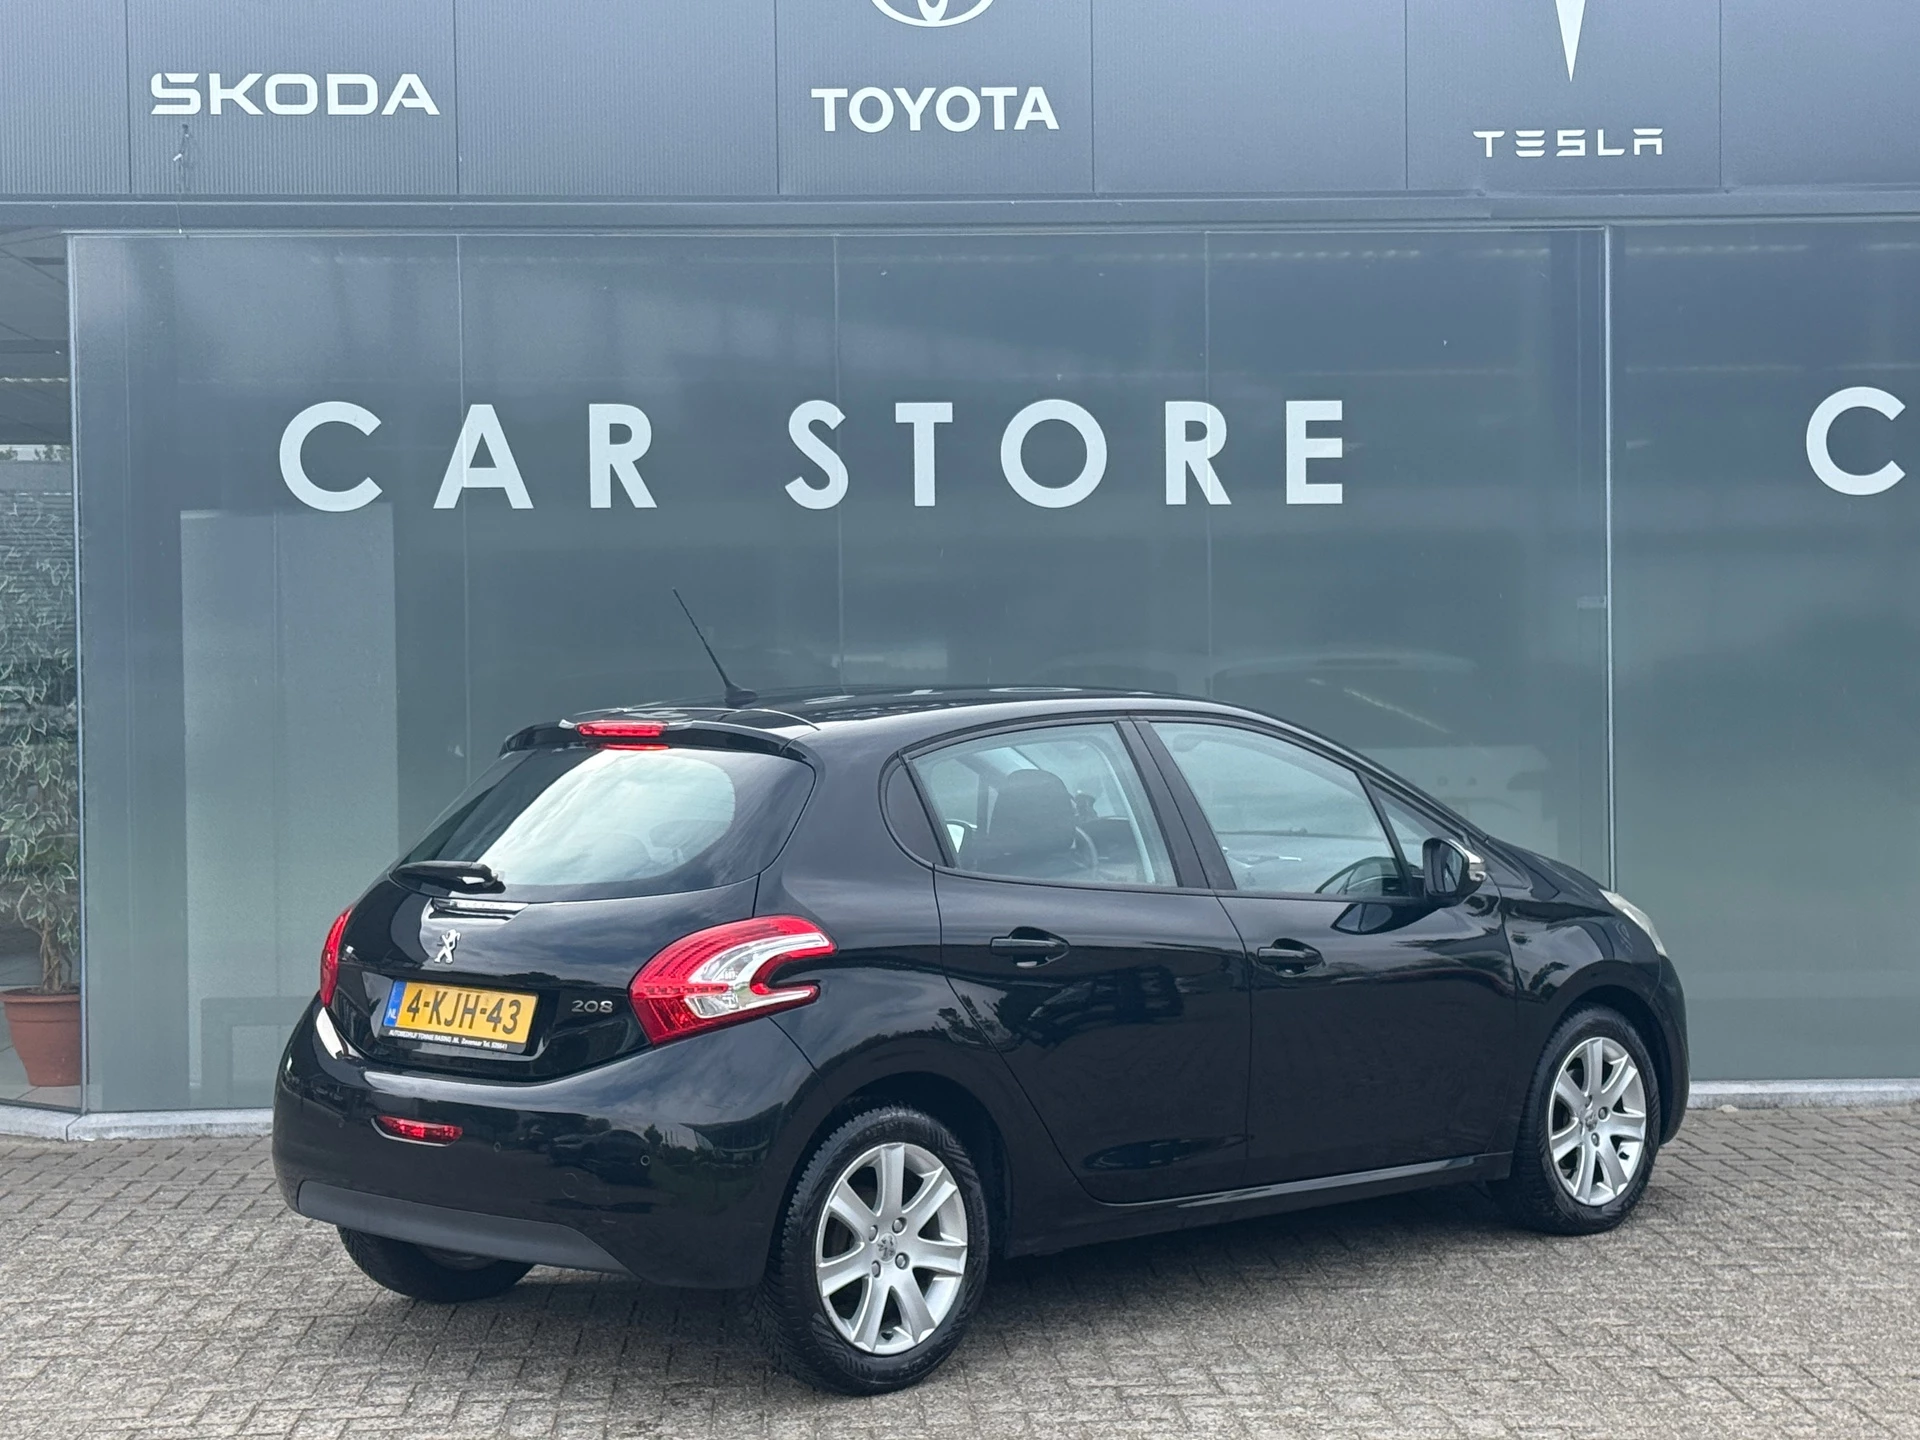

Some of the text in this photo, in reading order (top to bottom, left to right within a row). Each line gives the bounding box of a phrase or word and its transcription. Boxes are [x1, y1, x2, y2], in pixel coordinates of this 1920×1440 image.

[810, 86, 1060, 133] TOYOTA
[1473, 128, 1664, 158] TESLA
[279, 399, 1345, 512] CAR STORE
[1806, 386, 1907, 496] C
[406, 988, 522, 1035] 4-KJH-43
[571, 1000, 614, 1013] 208
